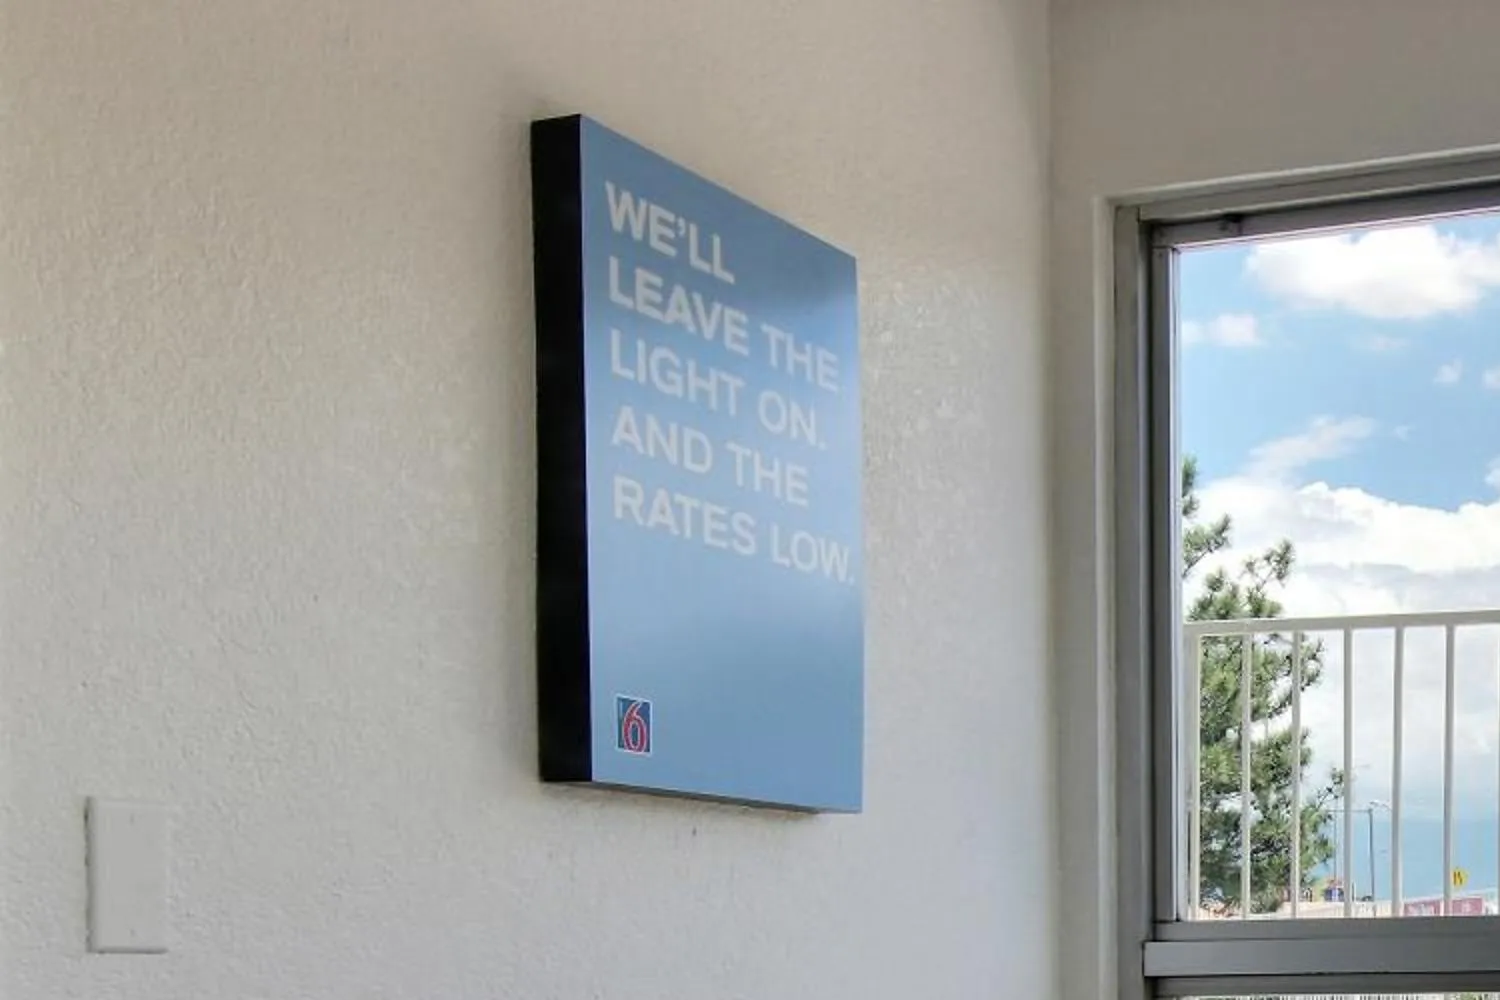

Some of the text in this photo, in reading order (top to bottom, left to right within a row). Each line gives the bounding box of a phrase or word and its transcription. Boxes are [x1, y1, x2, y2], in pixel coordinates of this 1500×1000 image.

[605, 180, 735, 285] WE'LL
[609, 255, 839, 394] LEAVE THE
[611, 327, 828, 450] LIGHT ON.
[612, 405, 809, 508] AND THE
[614, 475, 856, 585] RATES LOW.
[622, 700, 647, 753] 6
